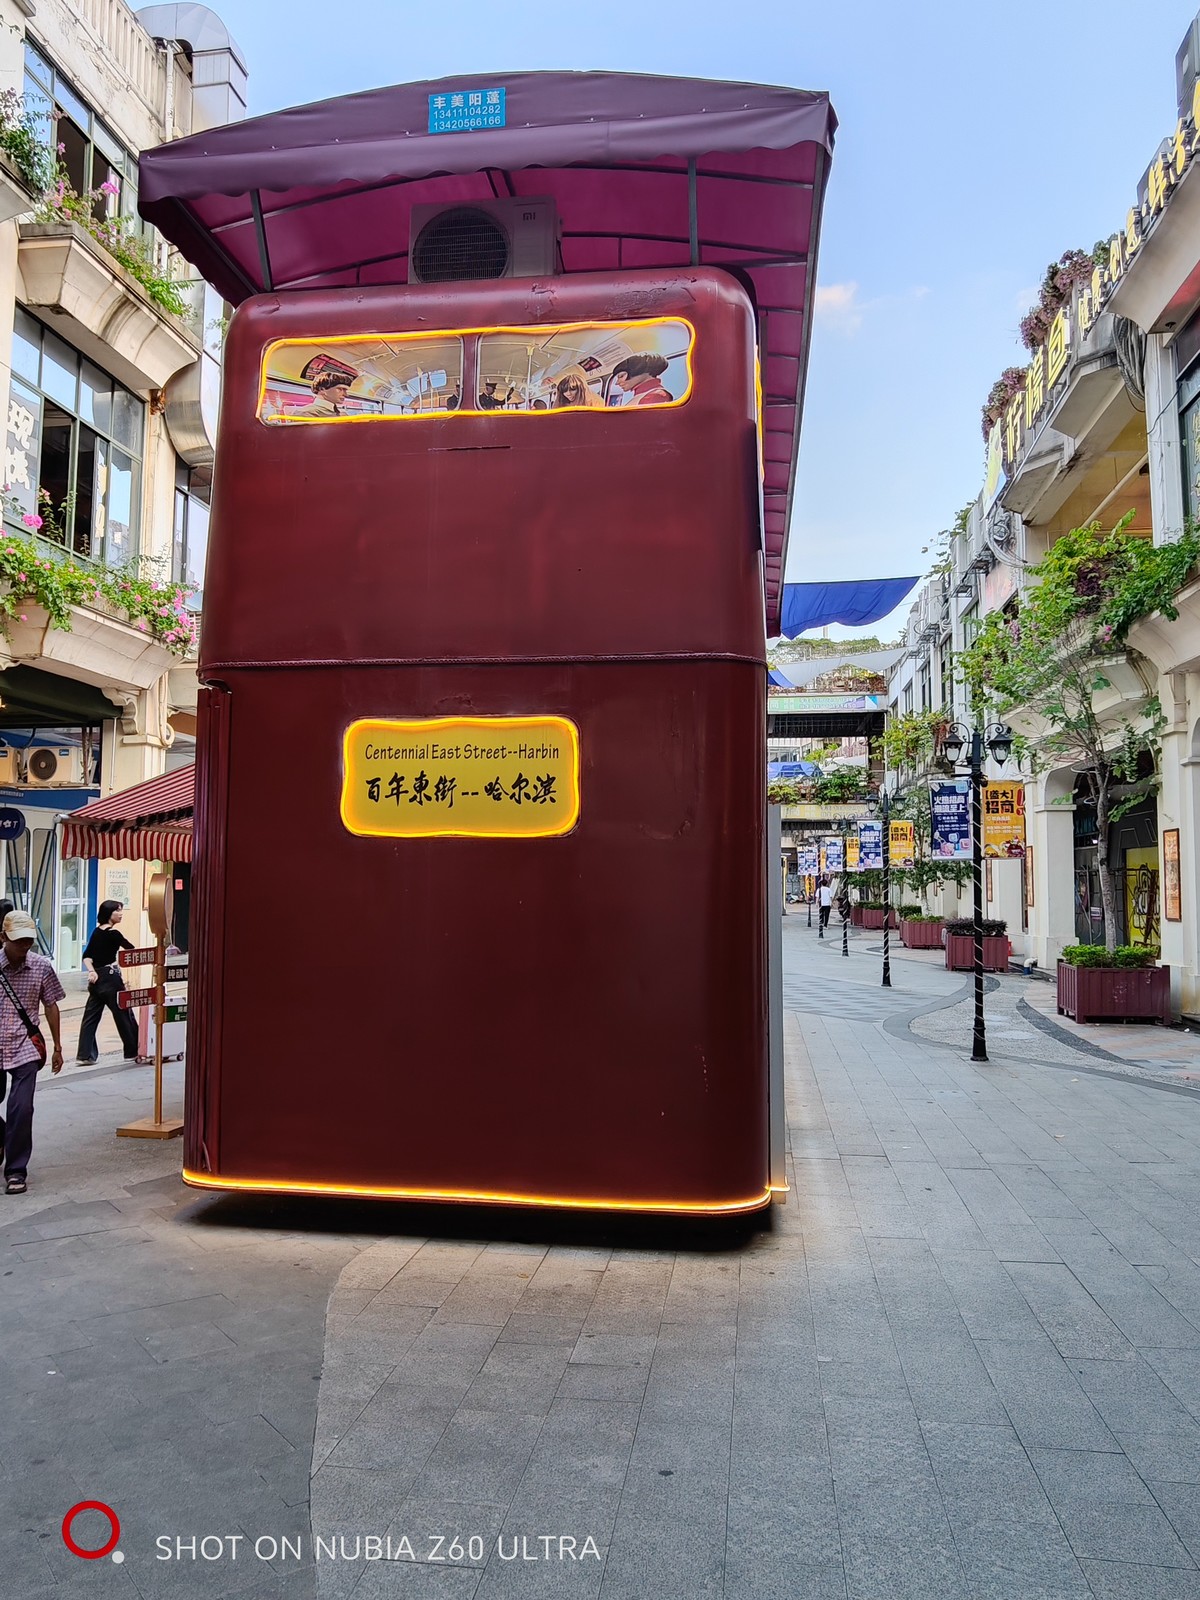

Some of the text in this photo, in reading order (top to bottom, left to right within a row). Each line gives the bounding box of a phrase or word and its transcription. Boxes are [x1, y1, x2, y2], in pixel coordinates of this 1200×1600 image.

[433, 105, 501, 119] 13411104282
[433, 116, 501, 130] 13420566166
[365, 743, 429, 760] Centennial
[432, 744, 462, 760] East
